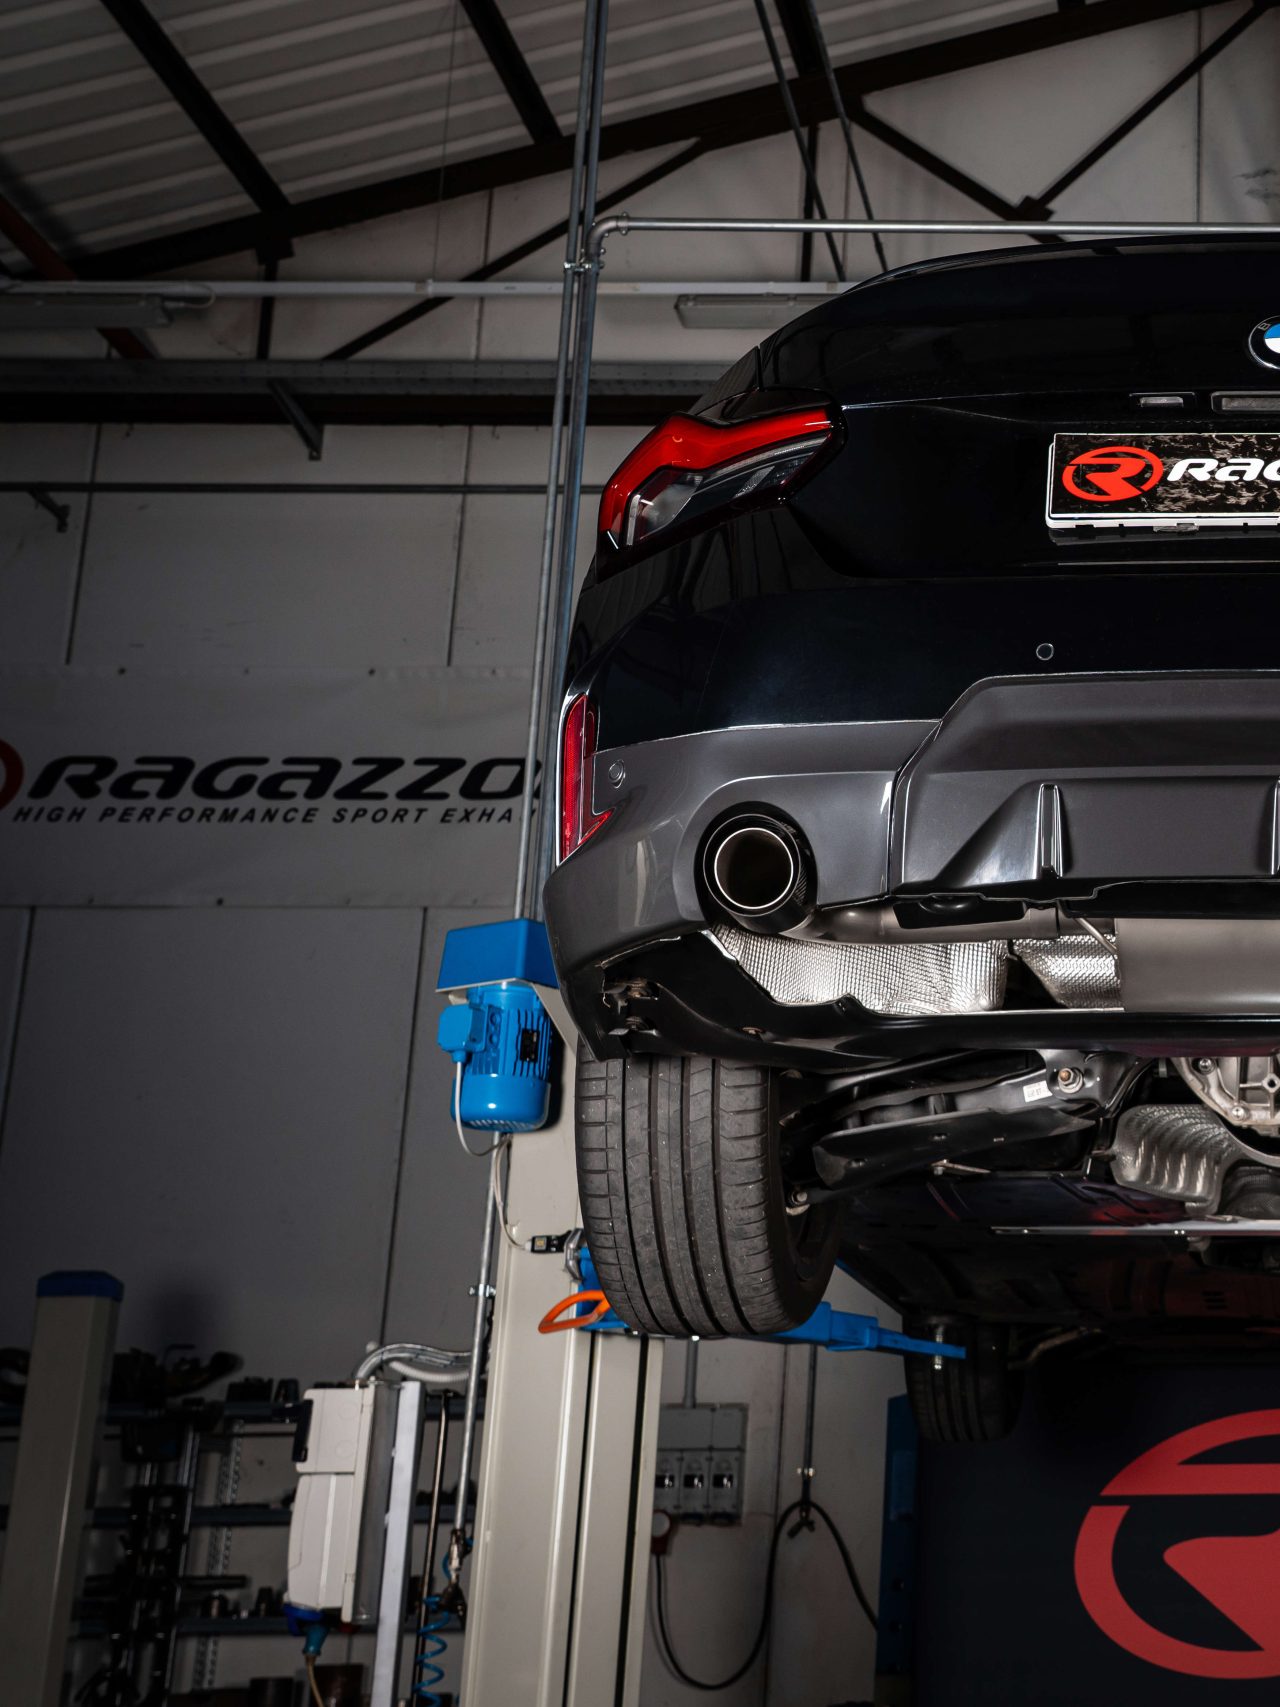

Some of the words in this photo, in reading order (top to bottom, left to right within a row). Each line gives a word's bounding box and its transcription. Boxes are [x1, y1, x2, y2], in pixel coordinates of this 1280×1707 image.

[27, 755, 541, 800] RAGAZZO
[12, 805, 87, 824] HIGH
[98, 806, 320, 824] PERFORMANCE
[331, 806, 429, 824] SPORT
[439, 806, 535, 824] EXHA
